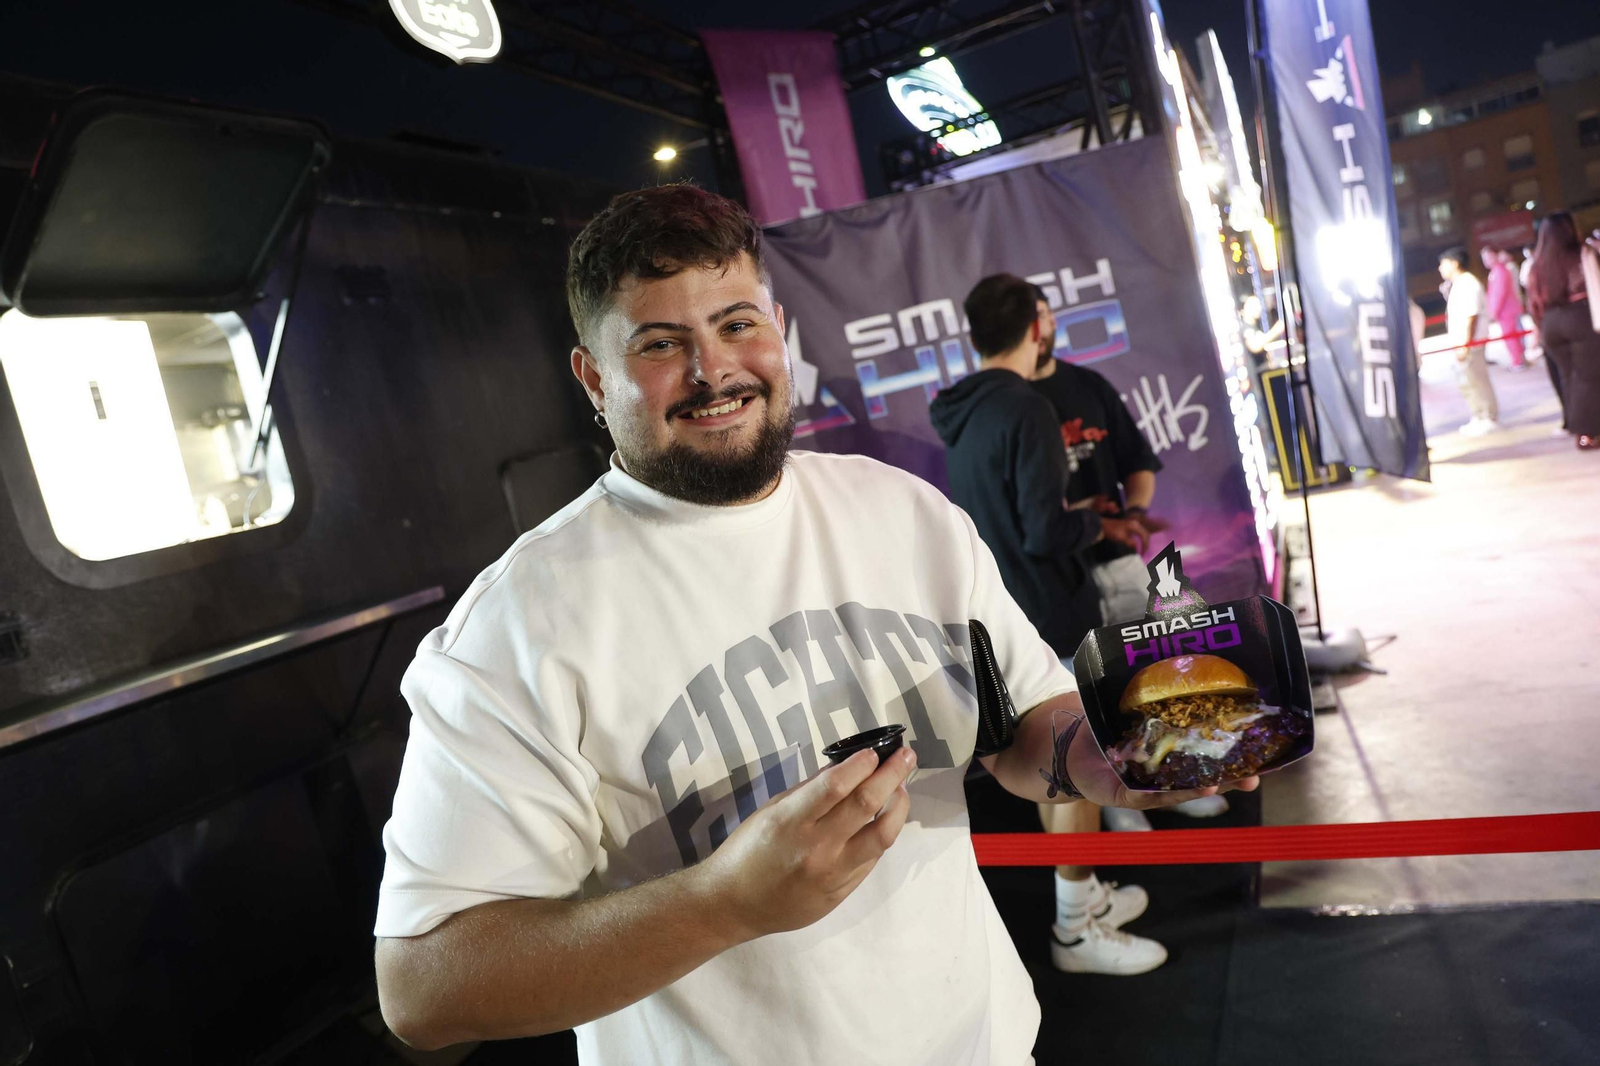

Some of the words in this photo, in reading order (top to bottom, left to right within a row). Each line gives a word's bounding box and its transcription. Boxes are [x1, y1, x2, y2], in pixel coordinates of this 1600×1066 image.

[767, 73, 824, 218] HIRO
[844, 258, 1116, 359] SMSH
[1332, 123, 1397, 418] SMSH
[855, 299, 1130, 420] HIO
[1121, 606, 1236, 642] SMASH
[1124, 623, 1242, 667] HIRO
